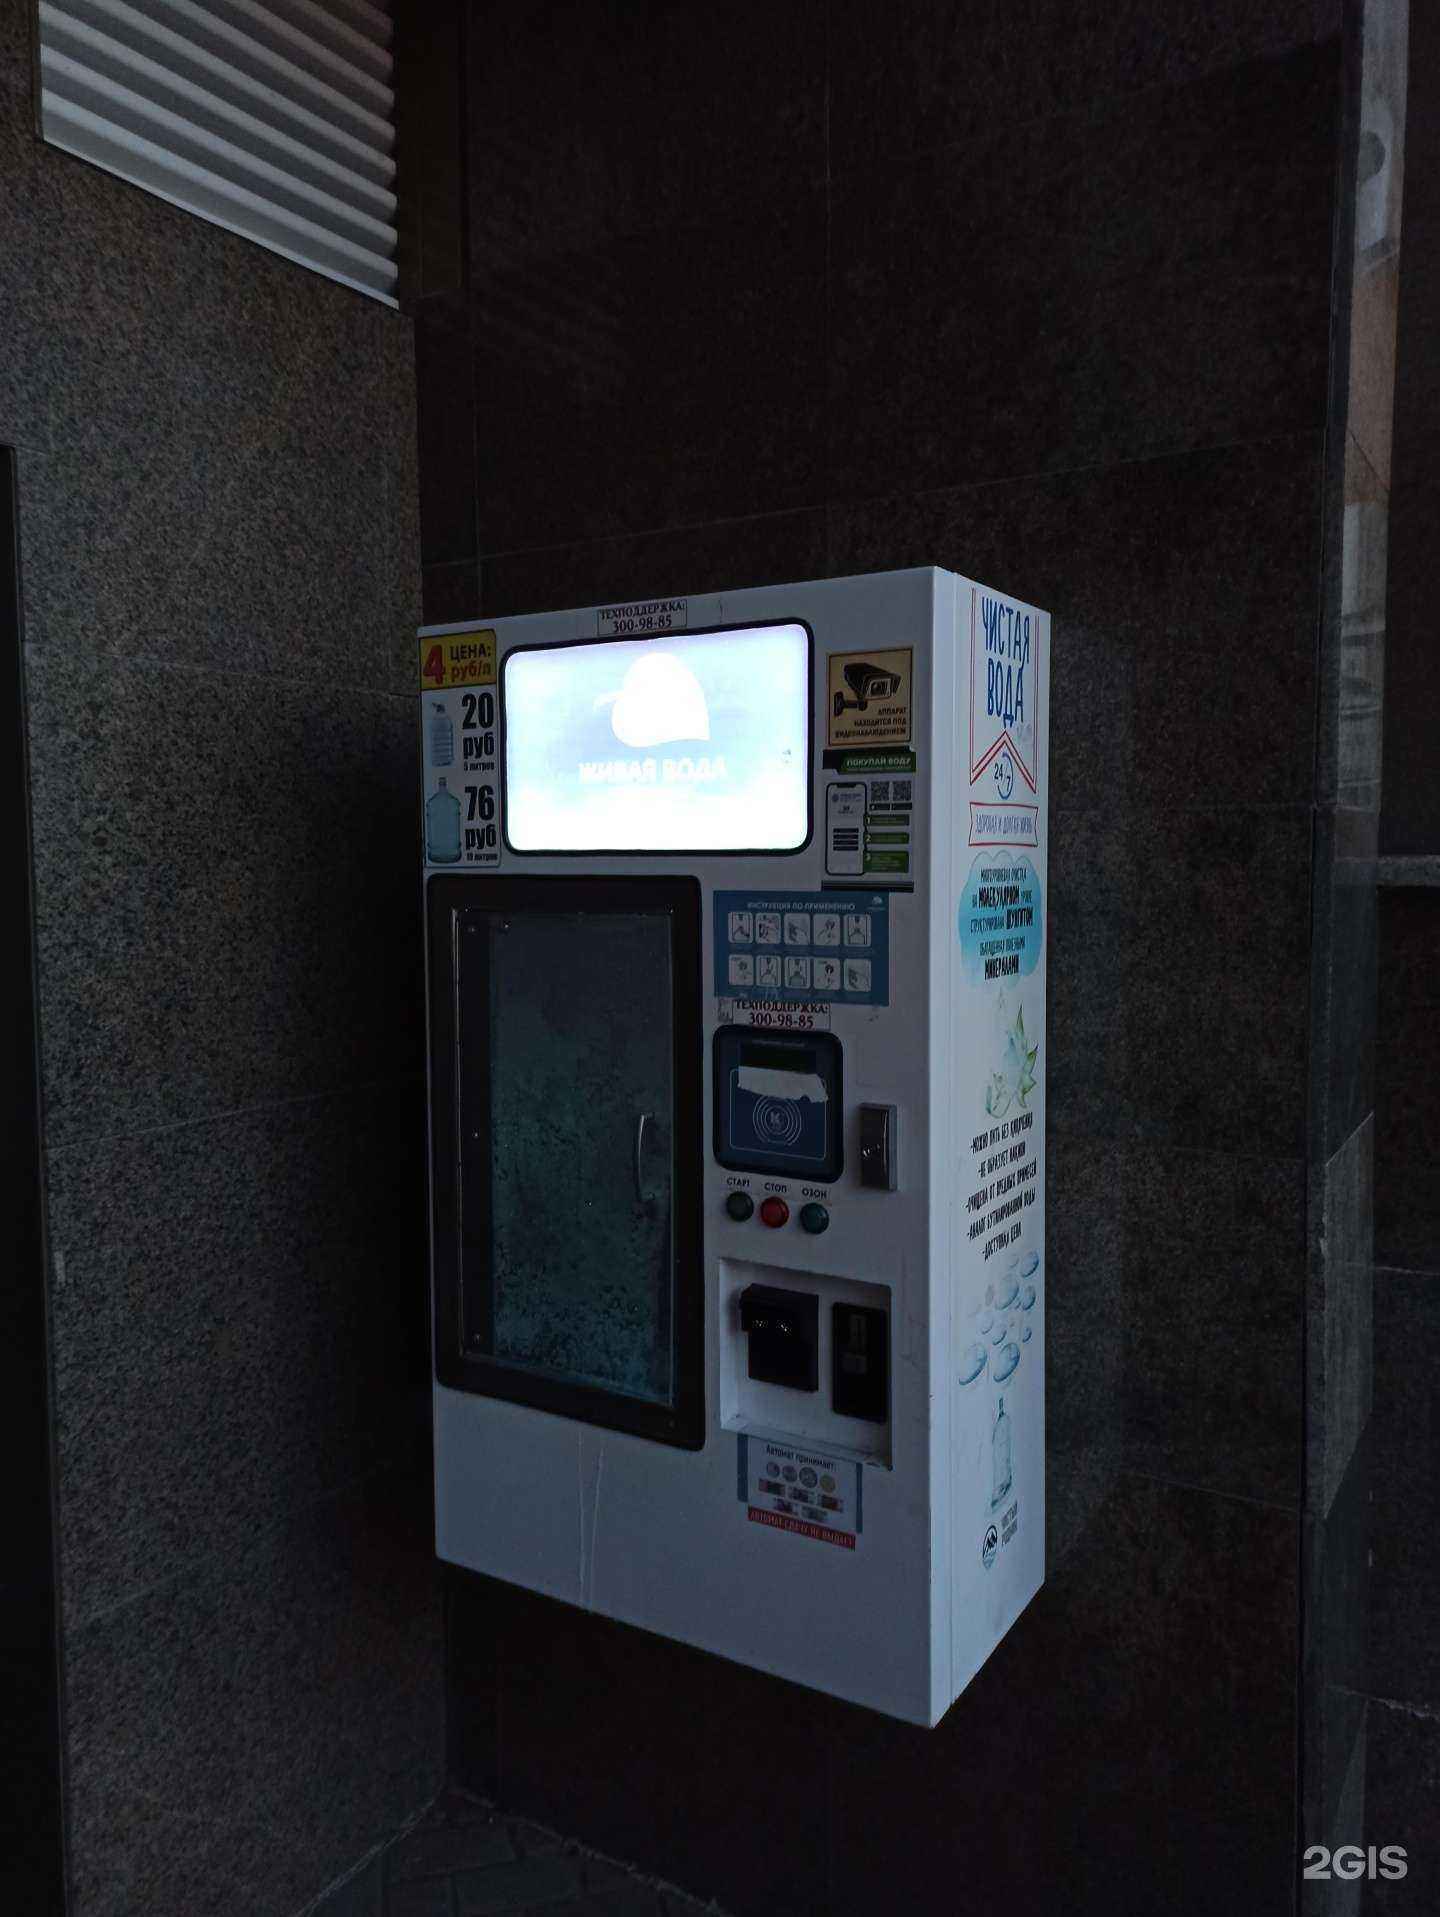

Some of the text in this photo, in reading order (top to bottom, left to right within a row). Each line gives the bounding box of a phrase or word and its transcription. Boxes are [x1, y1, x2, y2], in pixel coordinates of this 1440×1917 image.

[613, 615, 673, 633] 300-98-85
[982, 596, 1030, 665] ЧИСТАЯ
[422, 644, 446, 685] 4
[449, 643, 491, 663] ЦЕНА:
[451, 660, 491, 682] руб/л
[987, 658, 1024, 729] ВОДА
[461, 692, 494, 730] 20
[463, 731, 495, 759] руб
[464, 785, 495, 821] 76
[465, 824, 497, 850] руб
[750, 1012, 814, 1029] 300-98-85
[726, 1177, 750, 1187] СТАРТ
[764, 1182, 787, 1193] СТОП
[801, 1187, 828, 1199] ОЗОН
